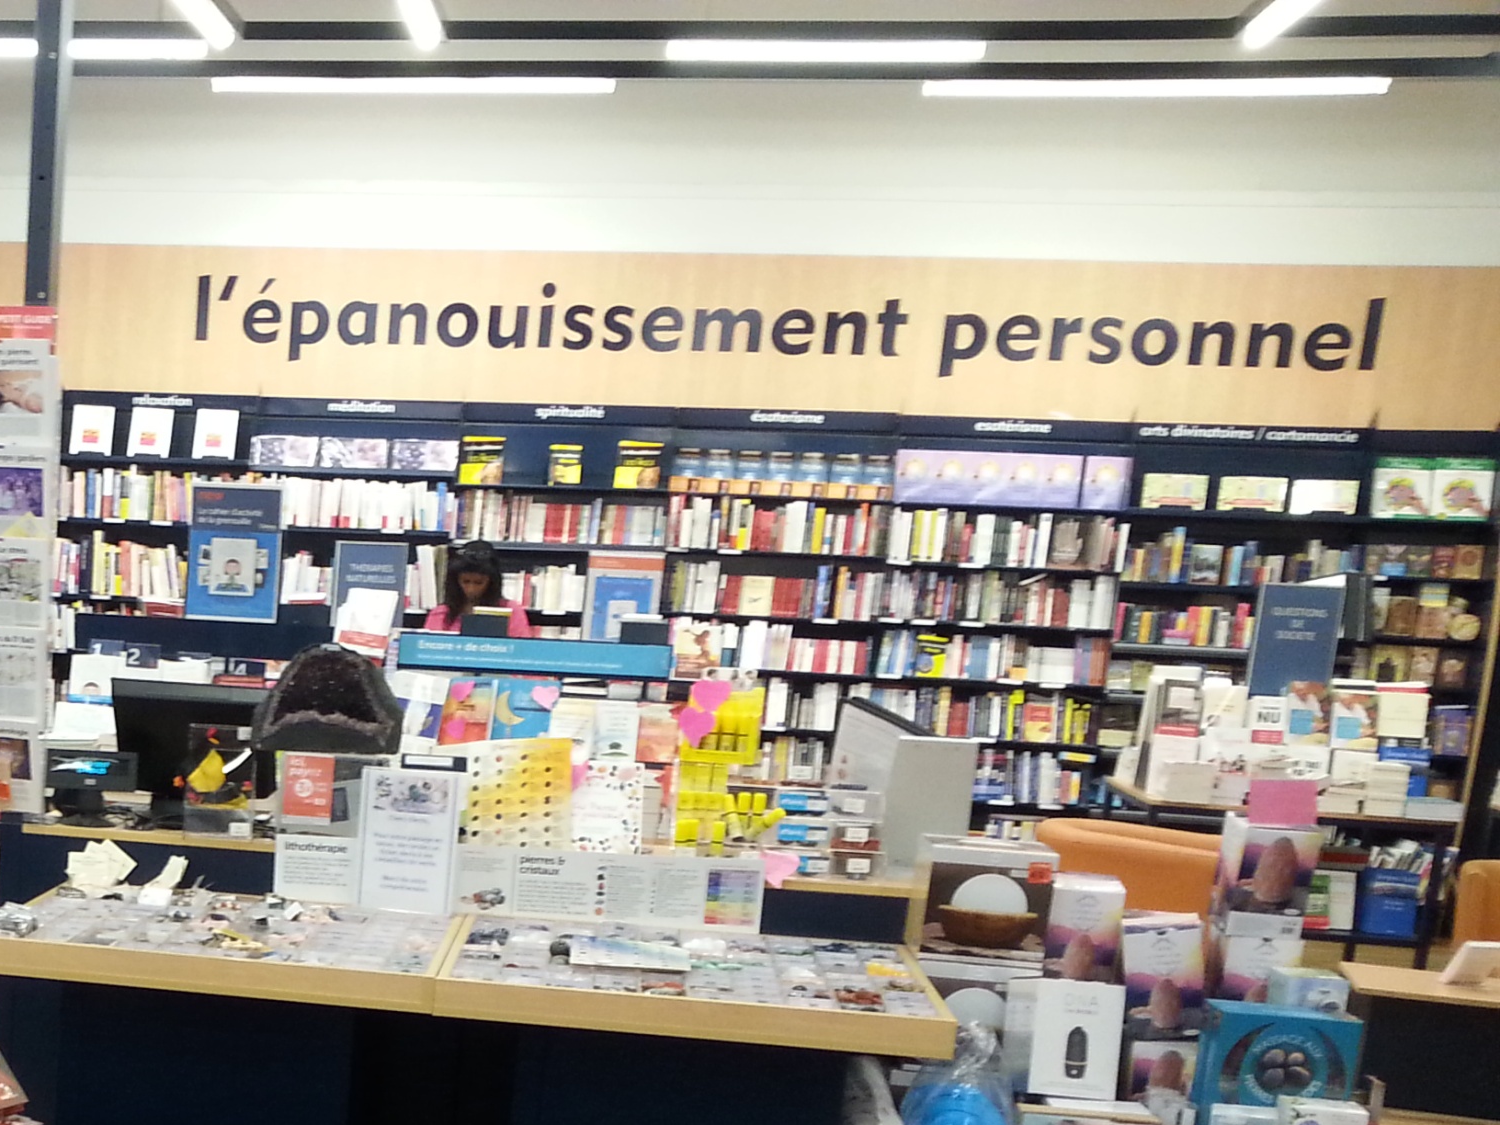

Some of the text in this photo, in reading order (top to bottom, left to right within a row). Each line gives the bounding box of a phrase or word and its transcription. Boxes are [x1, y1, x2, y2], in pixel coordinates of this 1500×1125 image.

[195, 274, 1387, 377] l'épanouissement personnel
[534, 405, 606, 420] spiritualité
[1139, 425, 1169, 437] arts
[1170, 424, 1255, 440] divinatoires
[1265, 429, 1359, 443] cartomancie
[127, 648, 141, 665] 2
[234, 662, 247, 676] 4
[519, 855, 555, 866] pierres
[519, 865, 560, 876] cristaux
